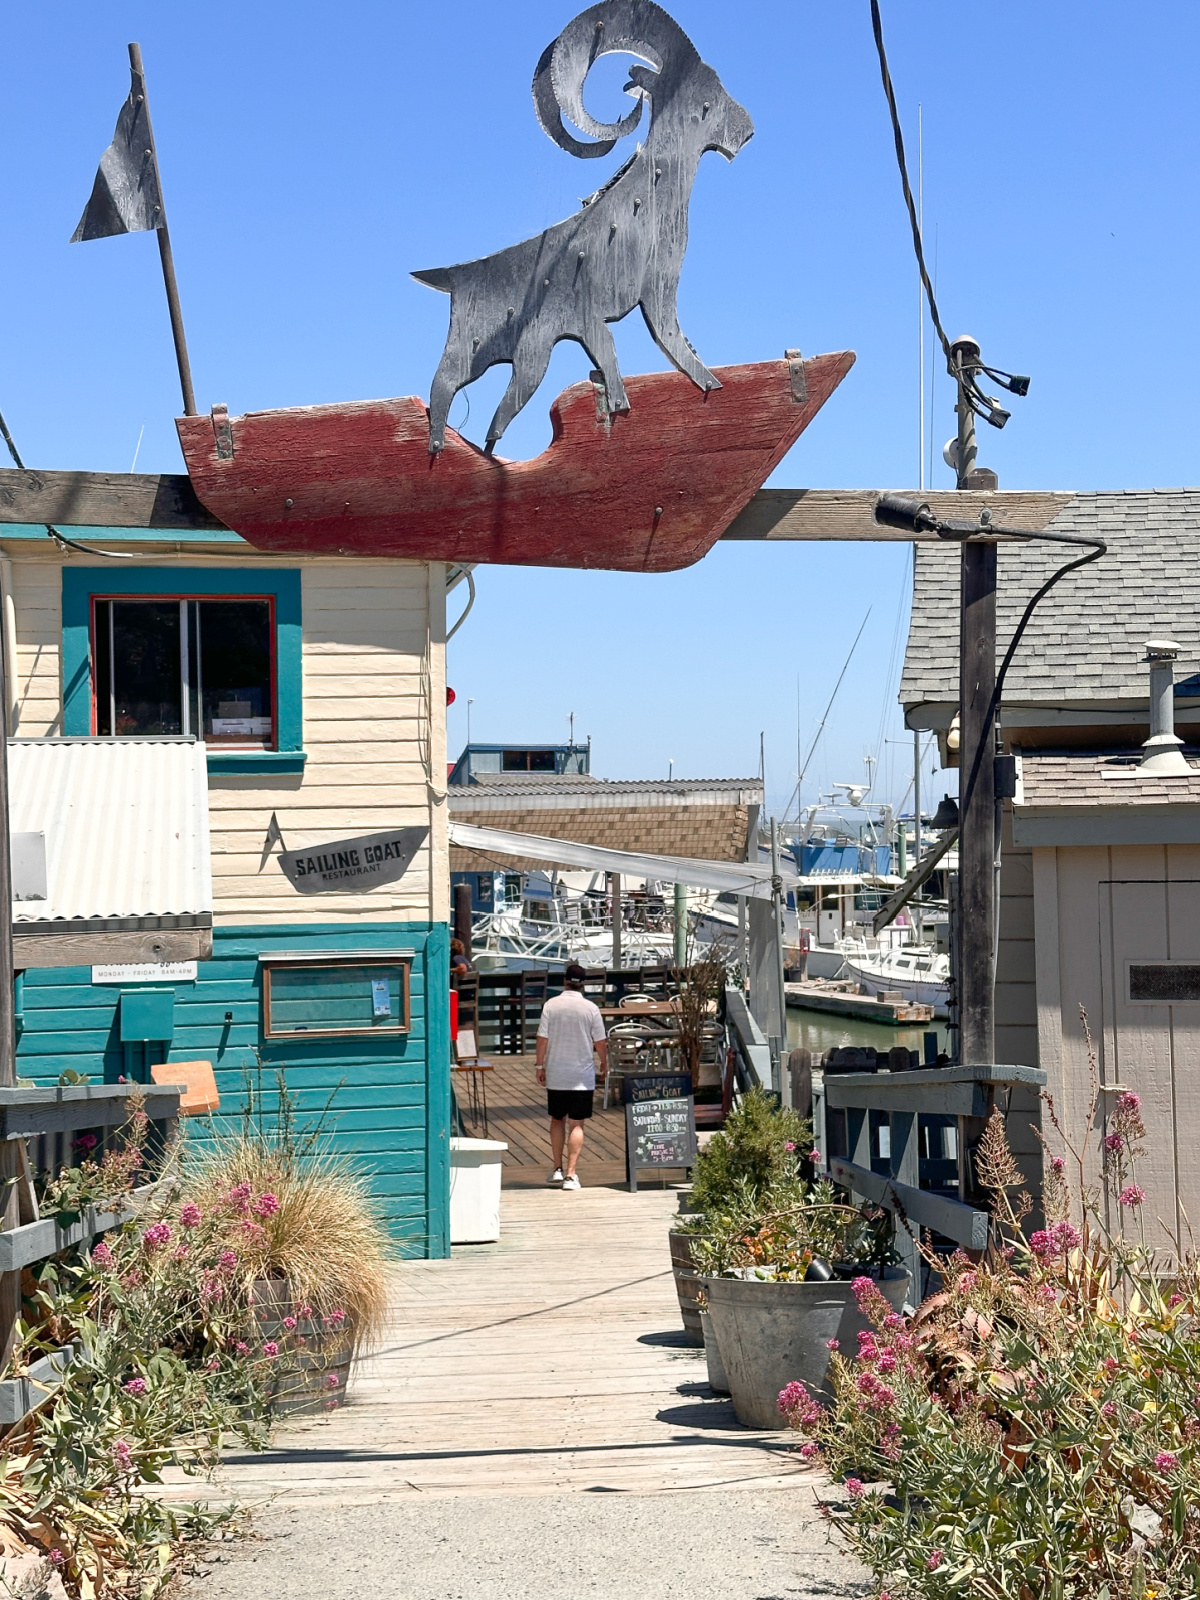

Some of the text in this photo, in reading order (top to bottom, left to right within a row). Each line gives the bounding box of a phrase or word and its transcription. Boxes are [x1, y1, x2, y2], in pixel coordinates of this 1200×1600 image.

[295, 841, 402, 876] SAILING GOAT
[322, 863, 382, 881] RESTAURANT
[632, 1104, 652, 1114] FRIDAY
